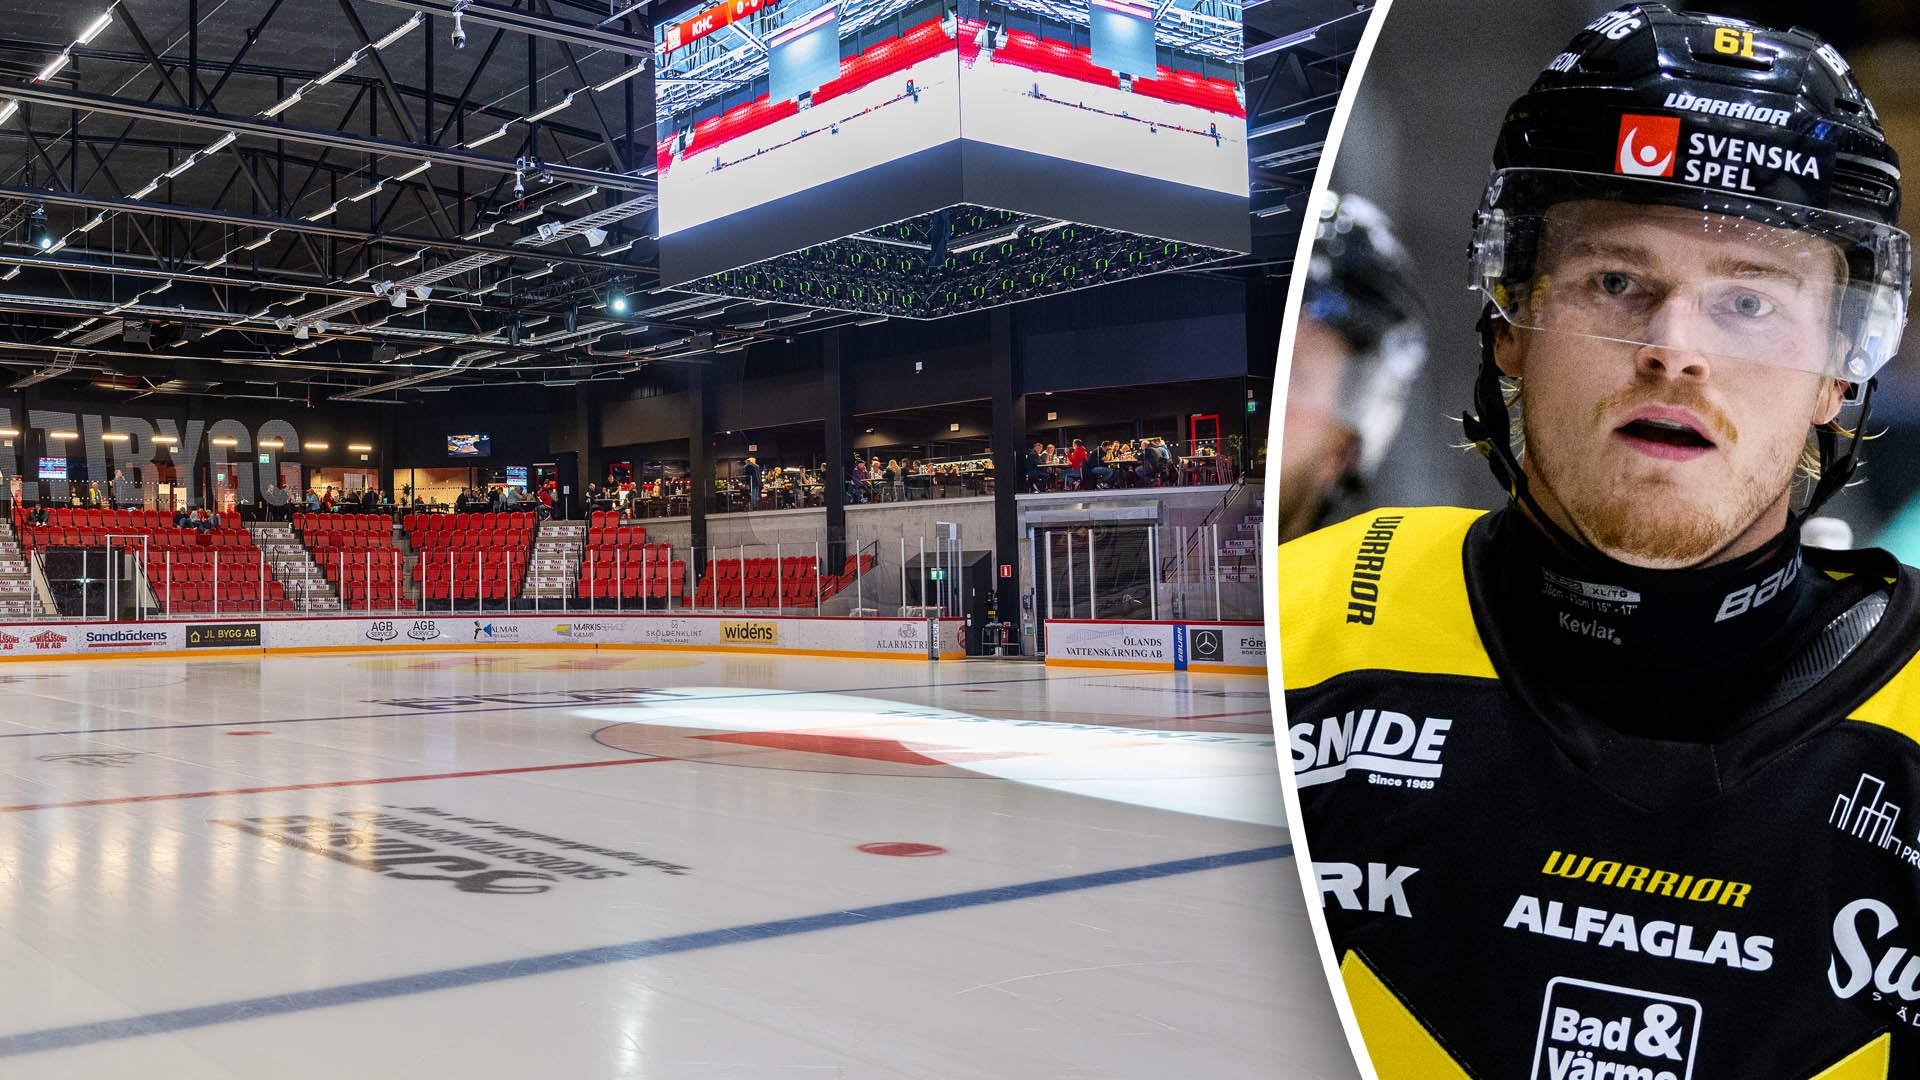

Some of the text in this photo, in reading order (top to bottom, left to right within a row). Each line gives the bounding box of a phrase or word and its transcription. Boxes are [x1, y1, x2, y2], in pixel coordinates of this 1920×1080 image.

[691, 15, 713, 37] KHC
[1713, 27, 1754, 58] 61
[1663, 92, 1792, 127] WARRIOR
[1688, 133, 1821, 181] SVENSKA
[1684, 159, 1756, 192] SPEL
[1346, 516, 1404, 626] WARRIOR
[1592, 588, 1628, 599] XL/TG
[204, 628, 257, 639] JL BYGG AB
[371, 621, 393, 632] AGB
[412, 620, 436, 631] AGB
[724, 623, 773, 641] widéns
[86, 630, 168, 642] Sandbäckens
[1123, 635, 1162, 647] ÖLANDS
[1066, 647, 1163, 658] VATTENSKÄRNING AB
[1368, 773, 1435, 790] Since 1969
[1541, 850, 1752, 908] WARRIOR
[1503, 894, 1775, 972] ALFAGLAS
[1551, 1003, 1683, 1062] Bad &
